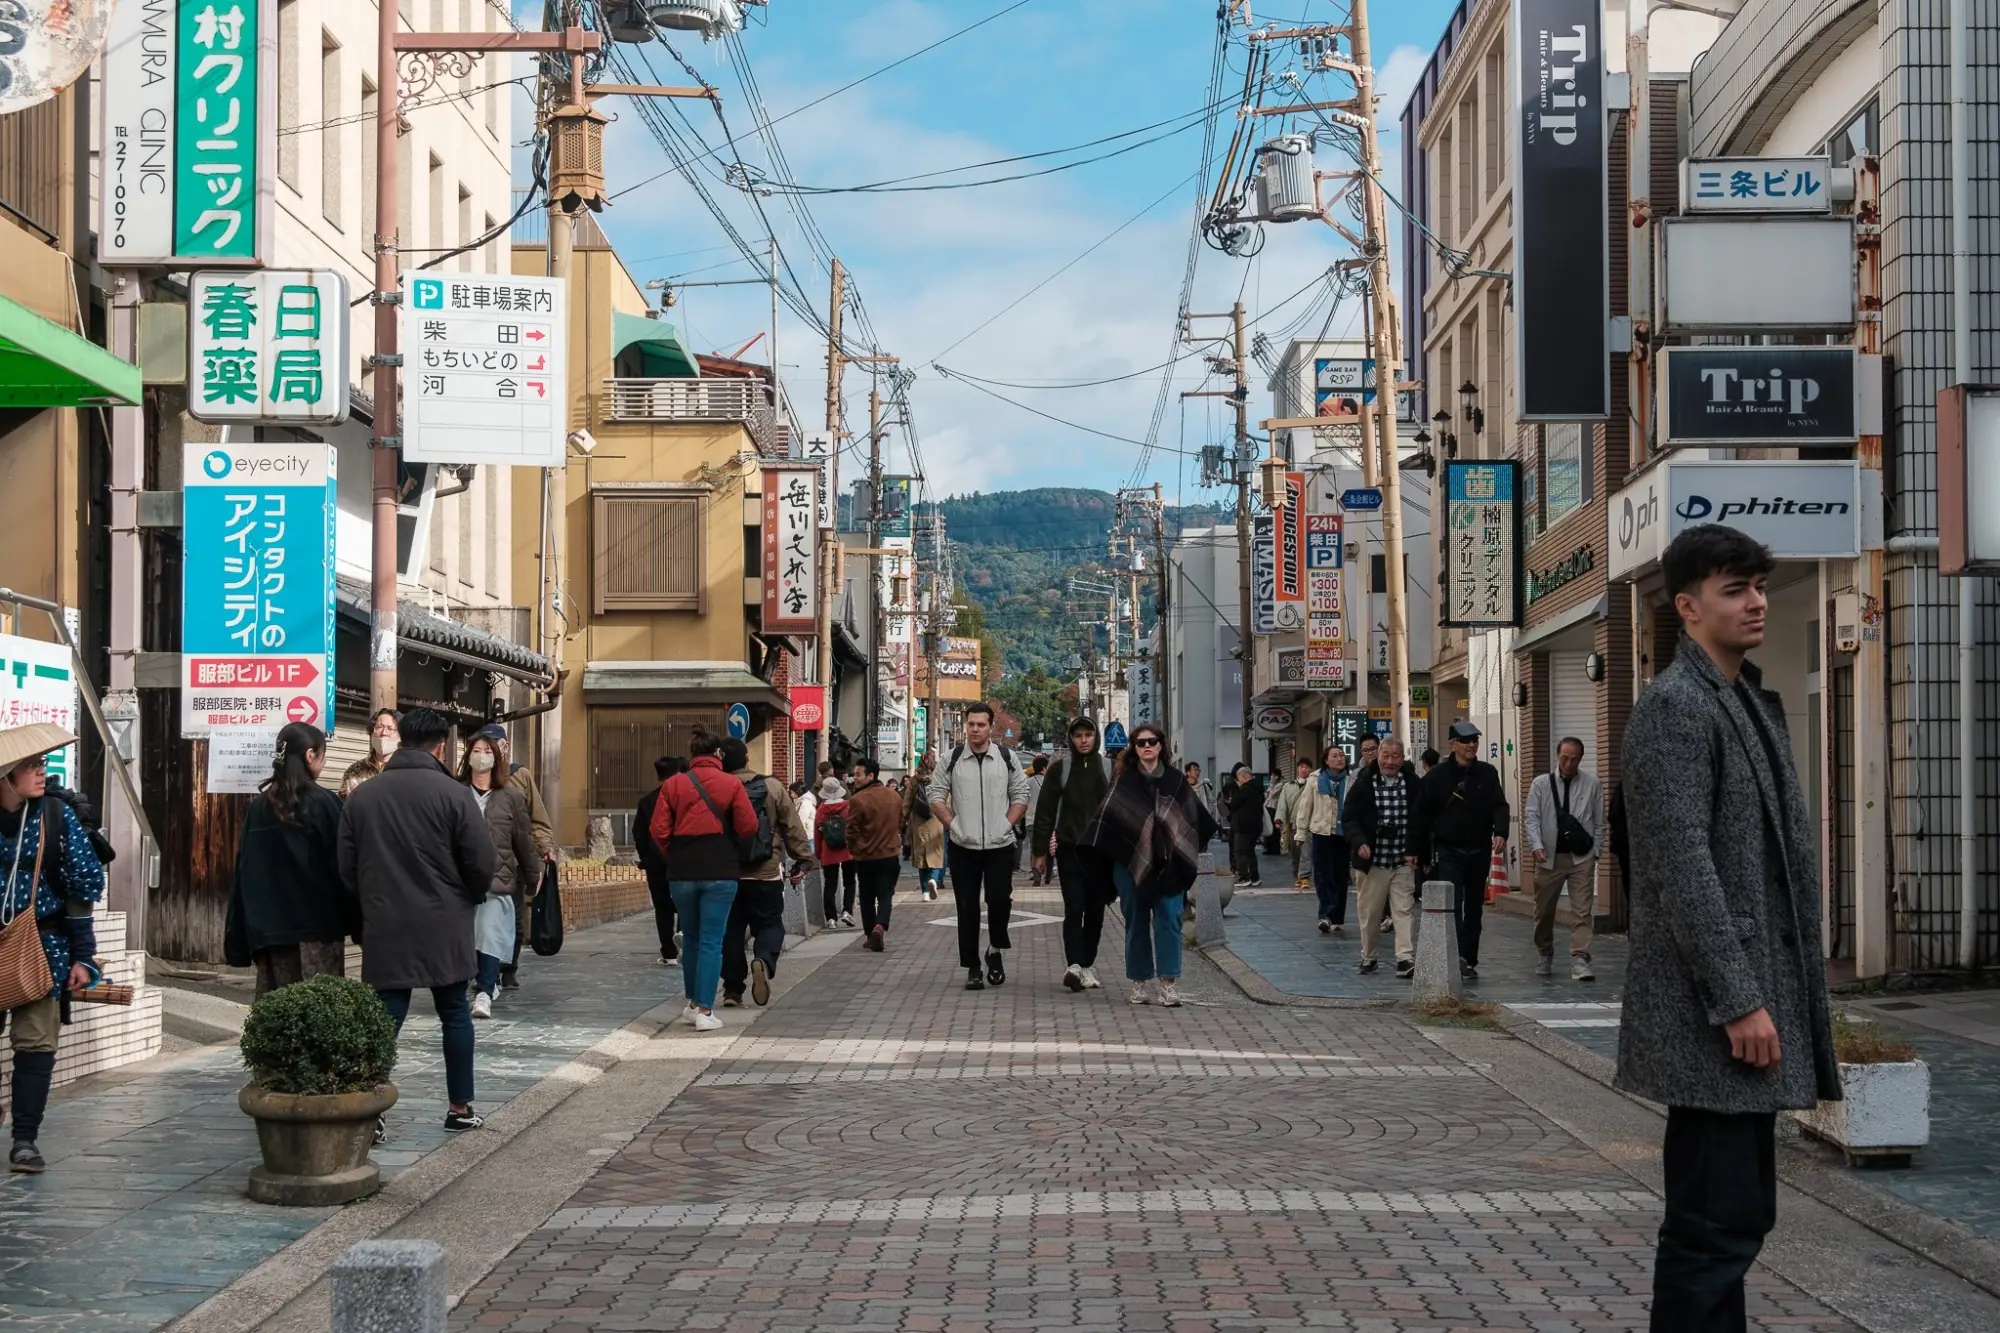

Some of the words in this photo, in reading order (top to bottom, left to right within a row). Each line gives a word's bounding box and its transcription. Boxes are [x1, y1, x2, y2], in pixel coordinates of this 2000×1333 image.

[1540, 30, 1548, 56] Hair
[1541, 58, 1548, 67] &
[1540, 25, 1587, 146] Trip
[1540, 70, 1549, 109] Beauty
[115, 127, 128, 137] TEL
[192, 5, 245, 249] 村クリニック
[140, 108, 166, 194] CLINIC
[1696, 169, 1821, 198] 三条ビル
[451, 284, 552, 312] 駐車場案内
[423, 348, 518, 370] もちいどの
[1701, 368, 1820, 414] Trip
[1706, 405, 1733, 413] Hair
[1746, 404, 1784, 414] Beauty
[235, 456, 309, 476] eyecity
[1465, 467, 1495, 498] 歯
[1717, 497, 1848, 522] phiten
[1310, 518, 1338, 531] 24h
[1310, 534, 1338, 546] 柴田
[1317, 549, 1333, 565] P
[224, 495, 257, 647] アイシティ
[261, 495, 285, 648] コンタクトの
[1458, 533, 1476, 617] クリニック
[198, 663, 273, 684] 服部ビル
[277, 664, 300, 682] 1F
[193, 697, 282, 711] 服部医院・眼科
[208, 714, 249, 725] 服部ビル
[252, 714, 267, 724] 2F
[1260, 716, 1290, 724] PAS
